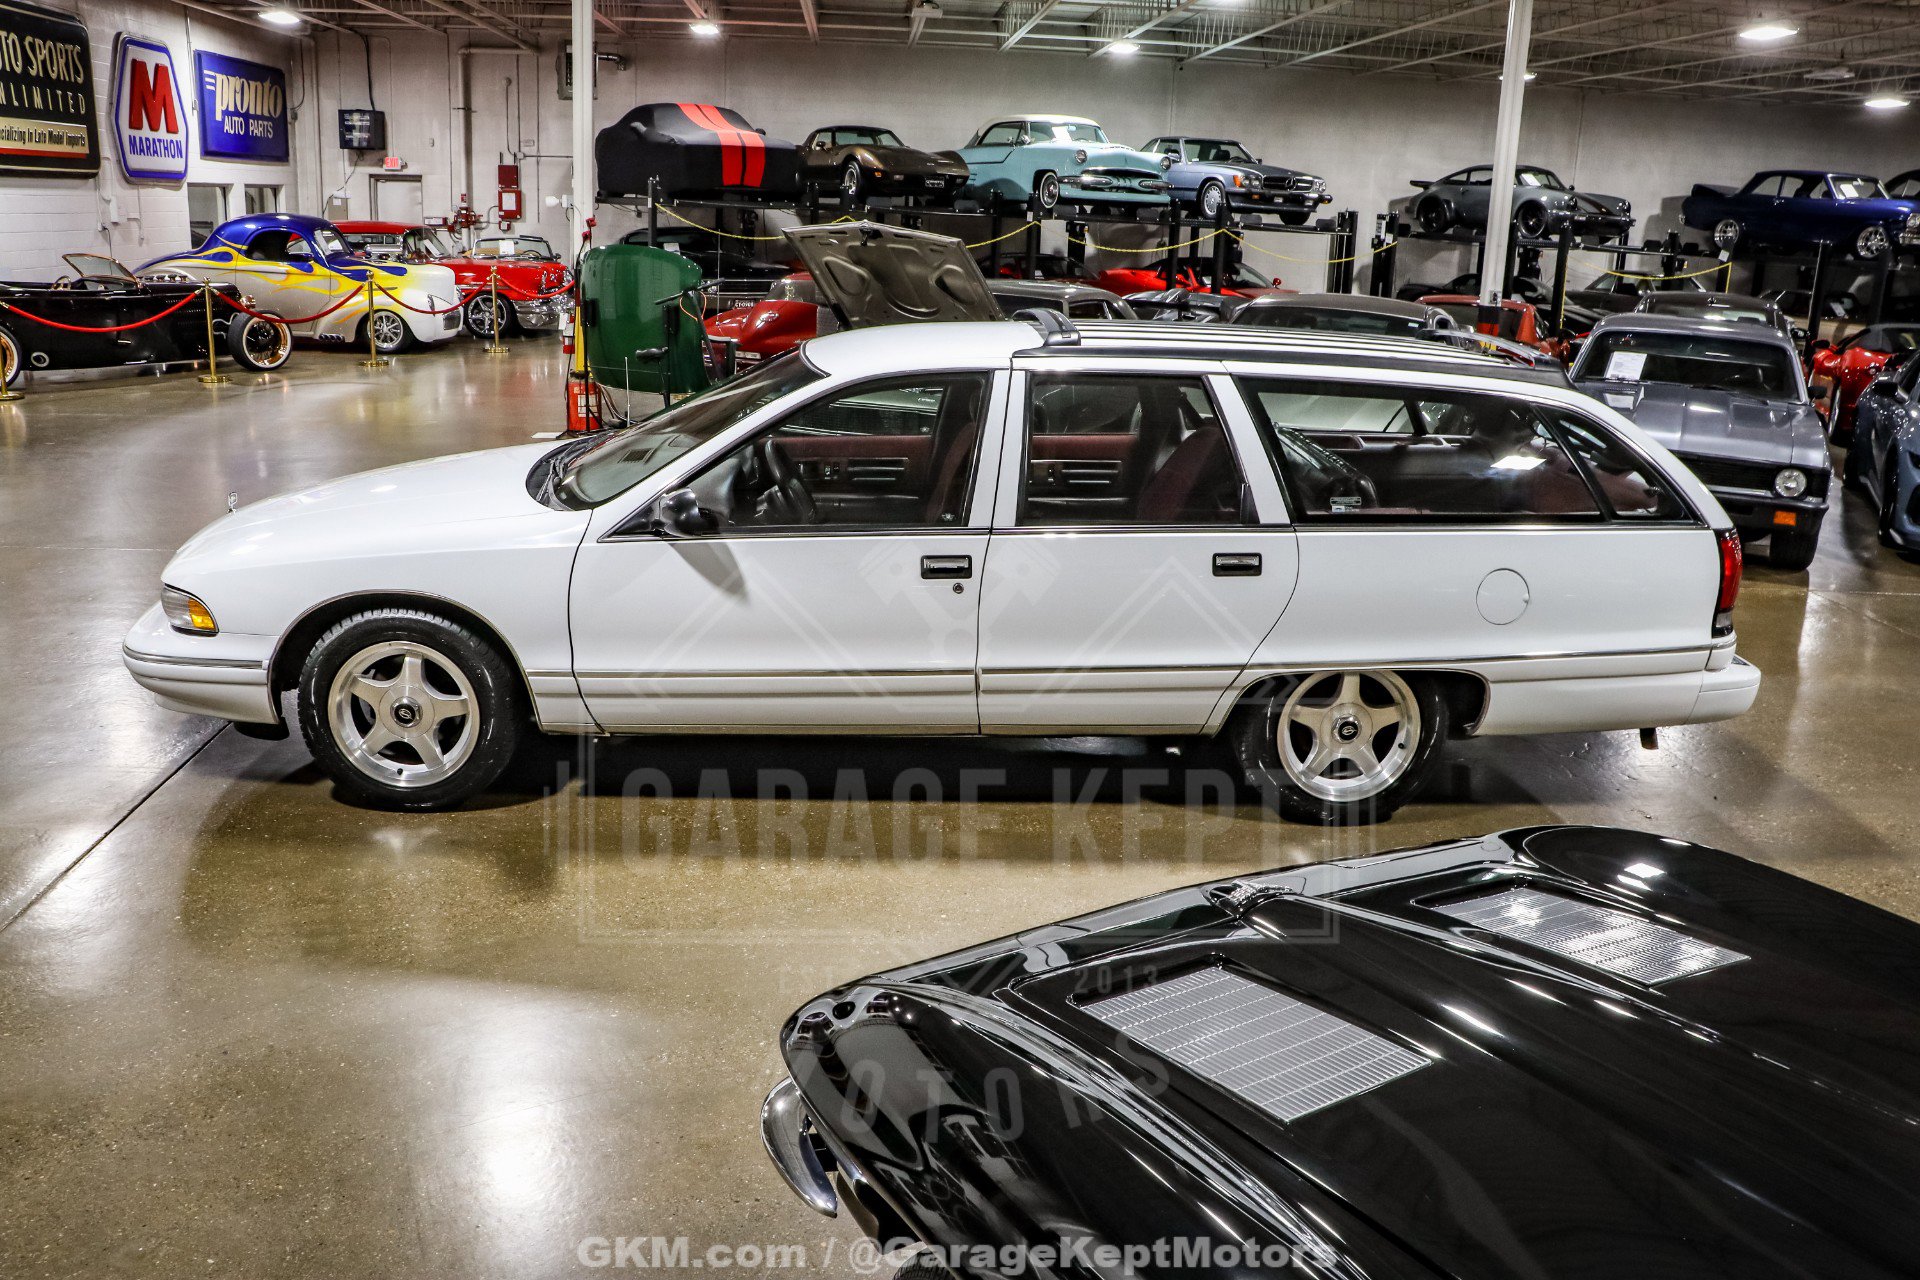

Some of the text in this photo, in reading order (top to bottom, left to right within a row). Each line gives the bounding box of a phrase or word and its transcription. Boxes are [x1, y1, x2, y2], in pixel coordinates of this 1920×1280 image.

[0, 30, 84, 84] TO SPORTS
[129, 59, 179, 134] M
[214, 72, 283, 121] pronto
[35, 128, 46, 144] Late
[48, 129, 64, 145] Model
[224, 116, 274, 138] AUTO PARTS
[129, 135, 183, 158] MARATHON
[385, 157, 399, 168] EXIT
